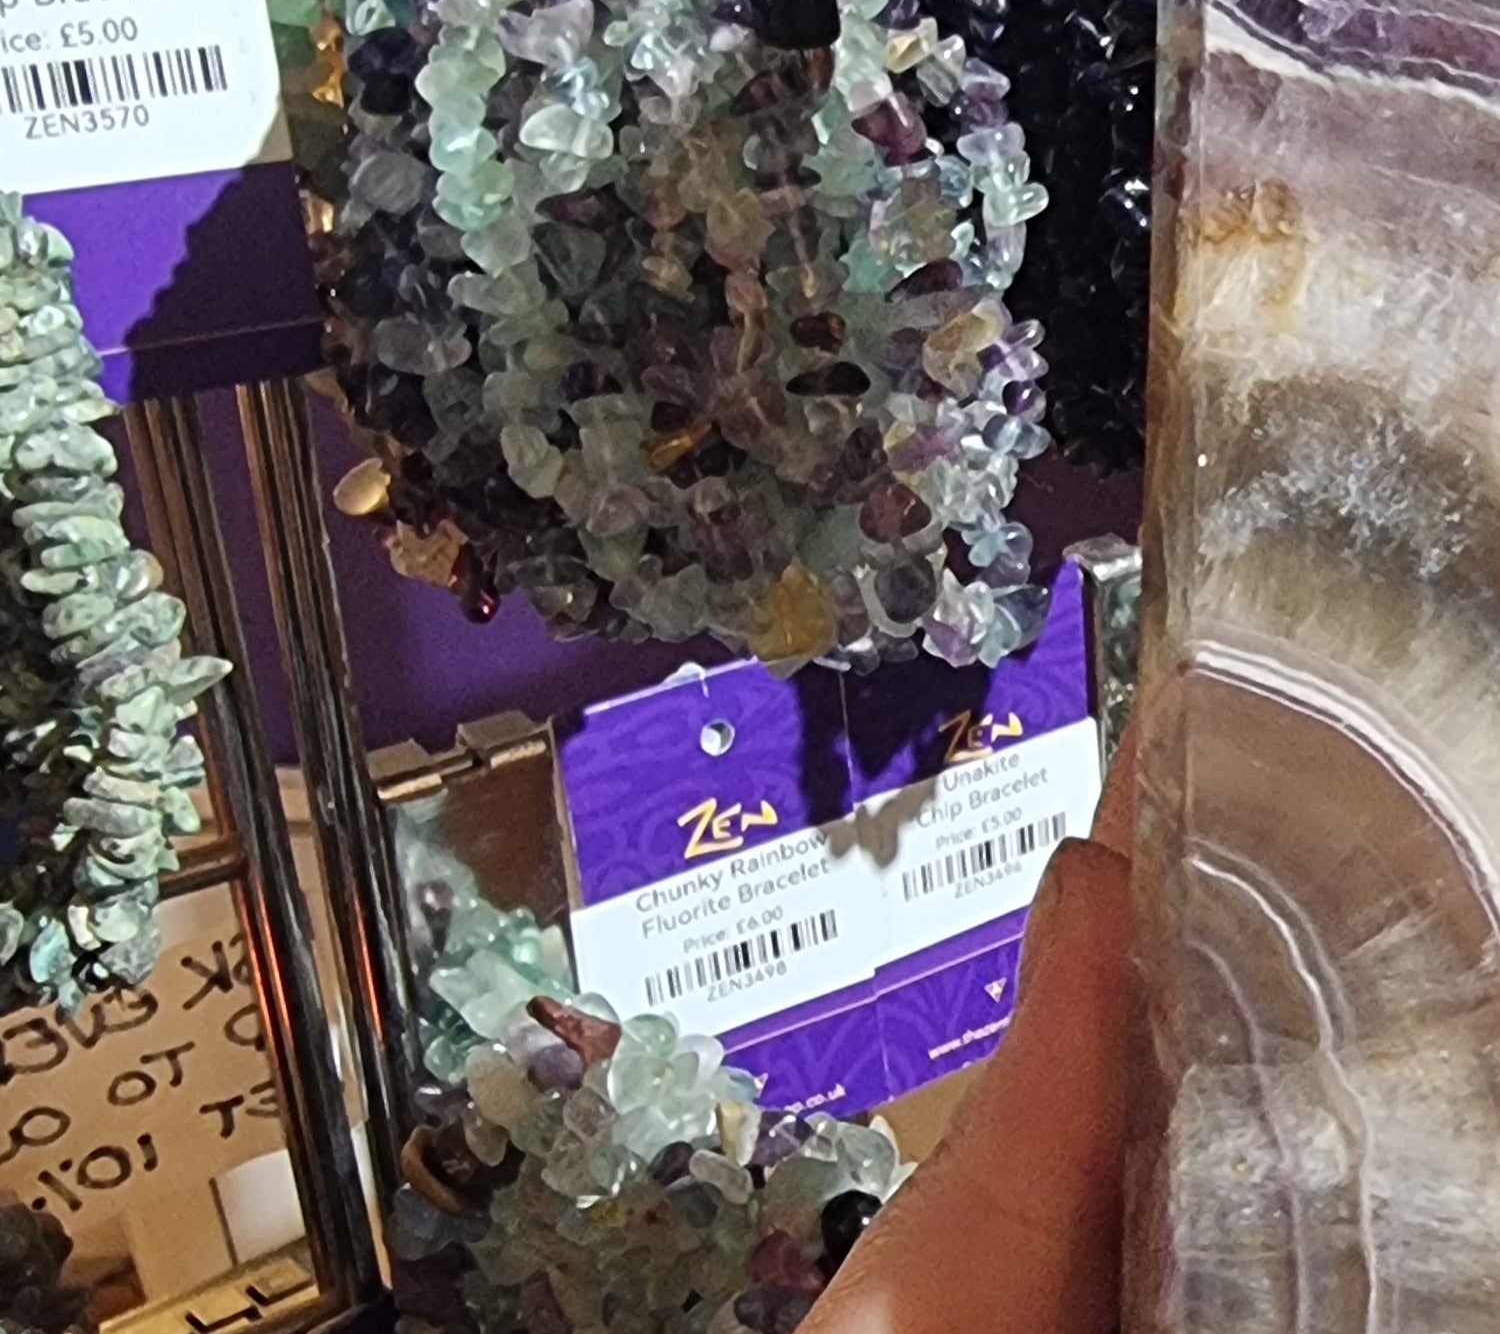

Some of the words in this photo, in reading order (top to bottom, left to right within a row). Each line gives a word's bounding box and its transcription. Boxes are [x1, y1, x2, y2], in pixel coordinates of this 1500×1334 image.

[0, 30, 50, 54] ice:
[60, 16, 138, 48] £5.00
[24, 104, 150, 140] ZEN3570
[937, 709, 1024, 765] ZEN
[916, 800, 963, 829] Chip
[968, 767, 1048, 811] Bracelet
[942, 753, 1020, 792] Unakite
[677, 797, 778, 859] ZEN
[981, 806, 1023, 834] £5.00
[635, 870, 723, 913] Chunky
[730, 832, 827, 879] Rainbow
[641, 895, 732, 939] Fluorite
[738, 857, 830, 904] Bracelet
